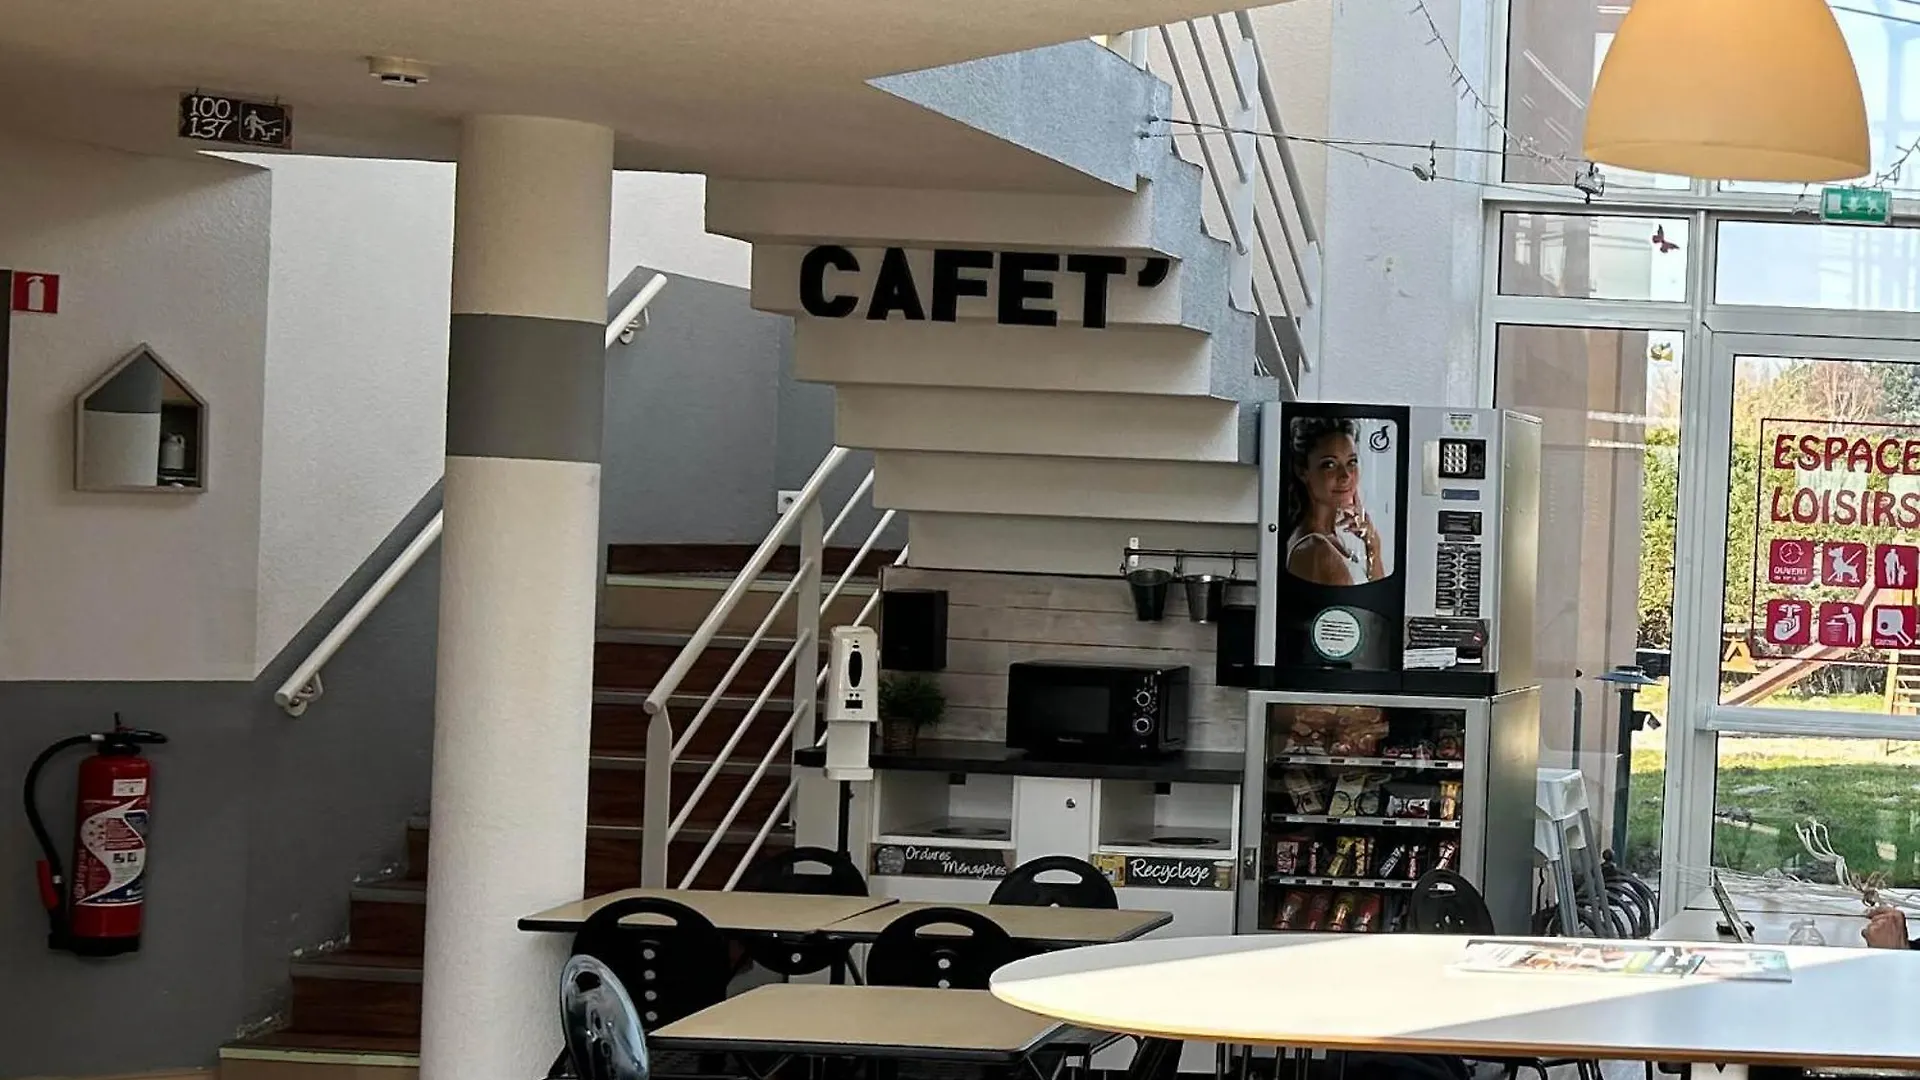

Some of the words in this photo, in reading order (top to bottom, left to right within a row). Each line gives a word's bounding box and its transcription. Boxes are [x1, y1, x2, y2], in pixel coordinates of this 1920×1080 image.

[190, 97, 231, 119] 100
[189, 117, 232, 138] 137
[1773, 434, 1920, 475] ESPACE
[1771, 486, 1920, 529] LOISIRS
[1773, 566, 1808, 575] OUVERT
[905, 845, 952, 861] Ordures
[1129, 858, 1210, 886] Recyclage
